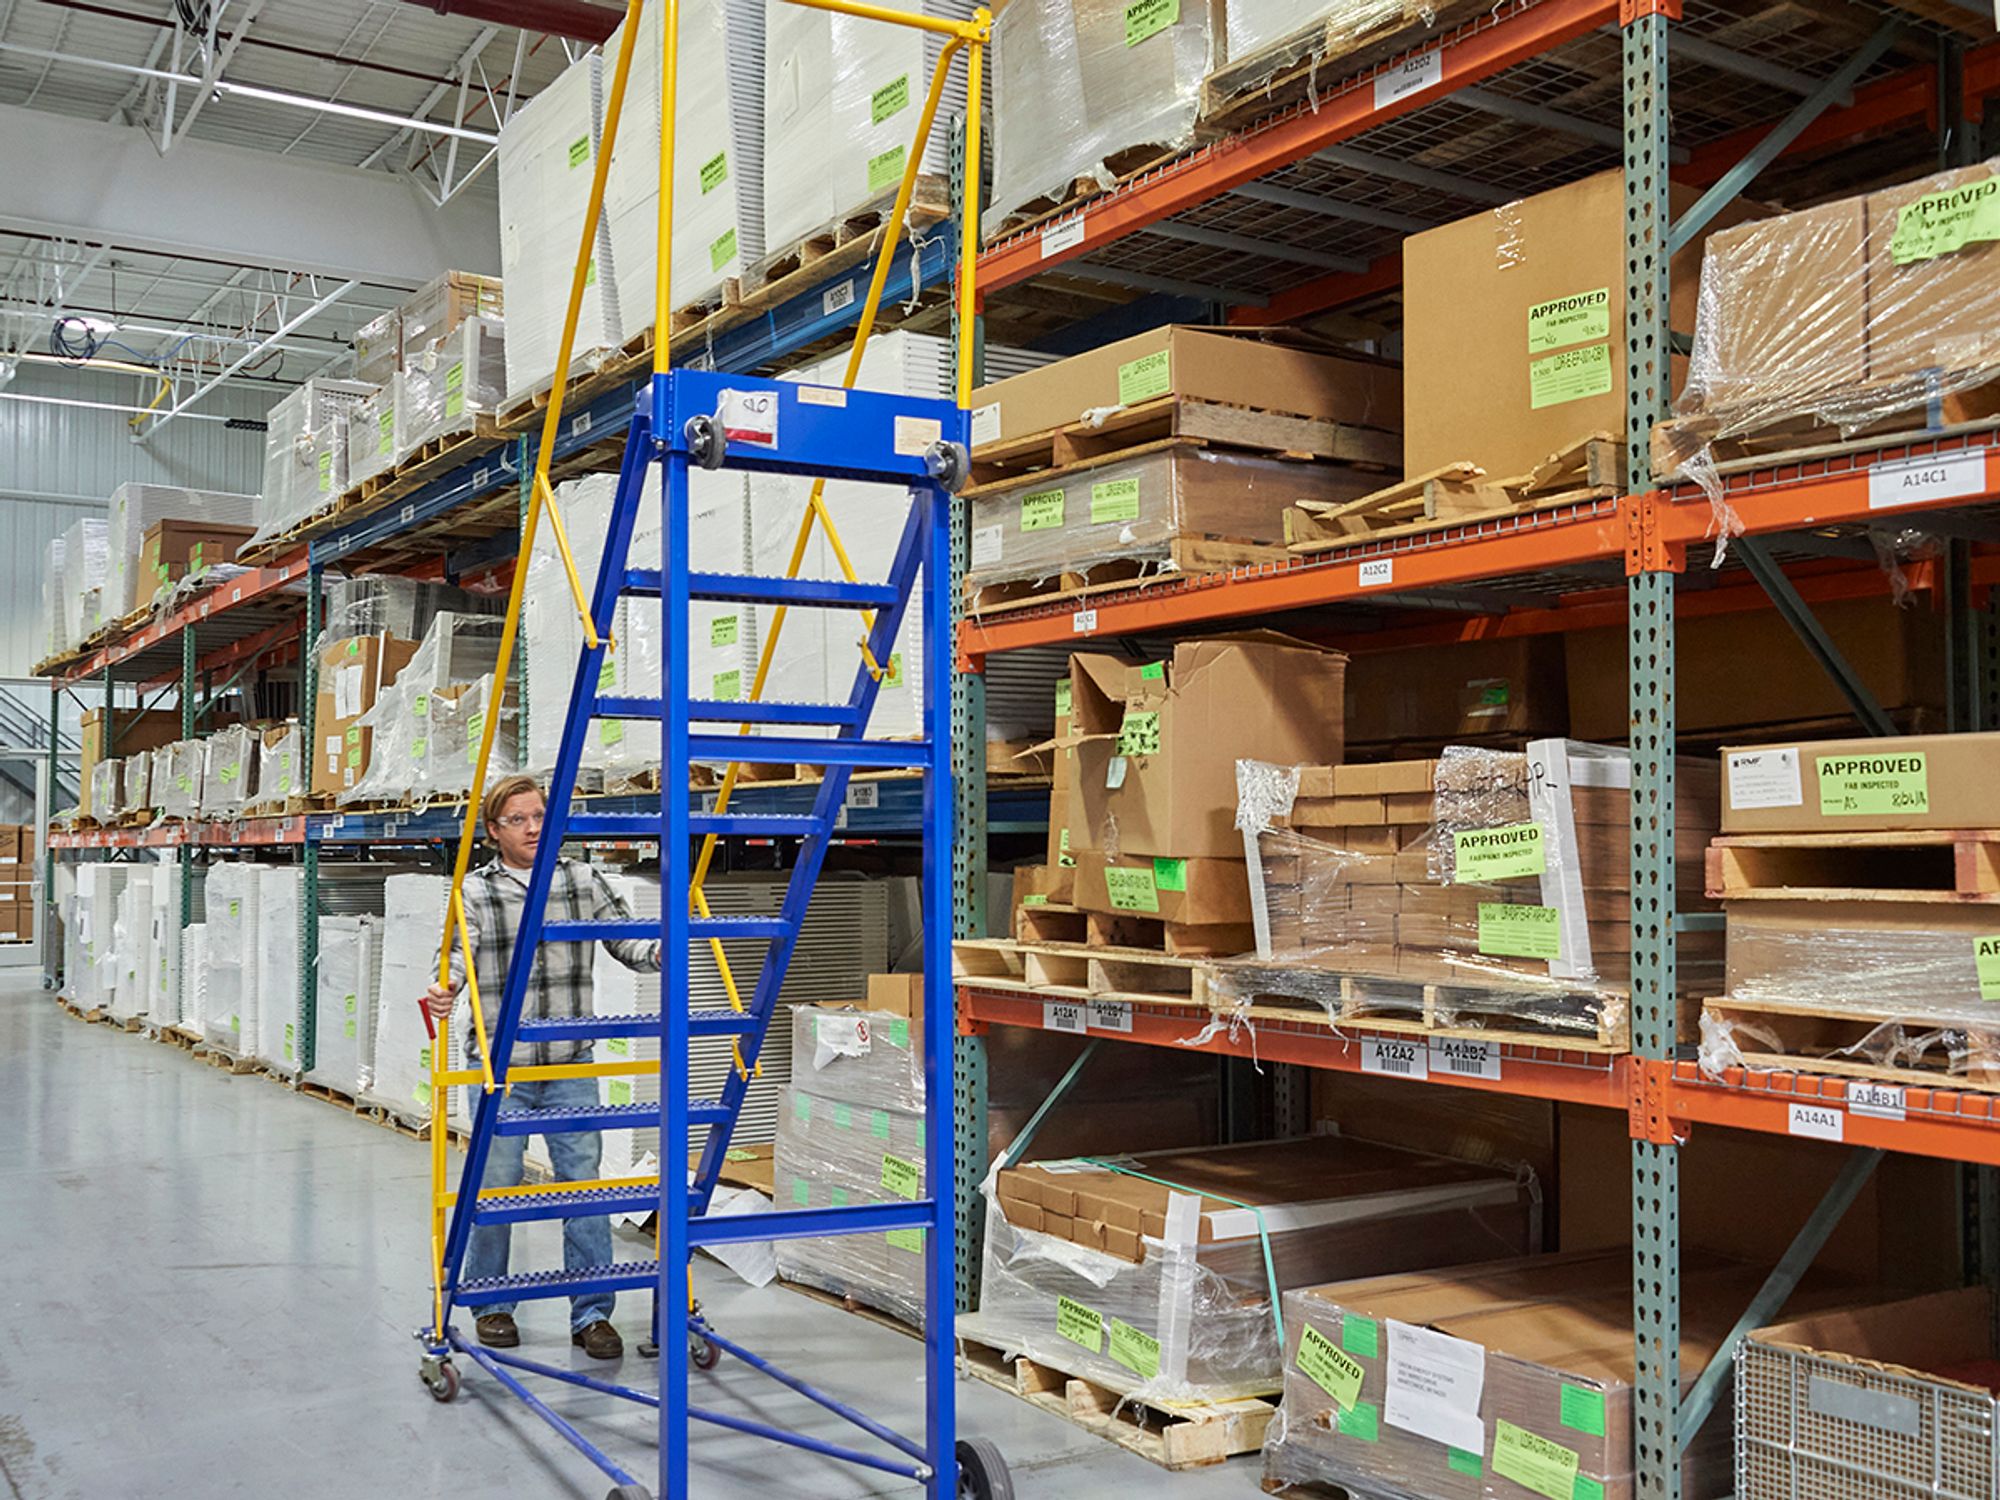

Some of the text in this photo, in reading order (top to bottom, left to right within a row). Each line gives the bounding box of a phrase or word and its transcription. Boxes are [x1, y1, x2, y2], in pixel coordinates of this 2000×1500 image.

[1531, 292, 1607, 320] APPROVED
[1903, 469, 1948, 488] A14C1
[1362, 563, 1389, 577] A12C2
[1822, 758, 1923, 777] APPROVED
[1844, 780, 1900, 791] FAB INSPECTED
[1460, 828, 1539, 849] APPROVED
[1053, 1006, 1078, 1020] A12A1
[1375, 1044, 1415, 1062] A12A2
[1444, 1043, 1487, 1062] A12B2
[1855, 1089, 1899, 1107] A14B1
[1794, 1109, 1837, 1127] A14A1
[1305, 1330, 1360, 1380] APPROVED
